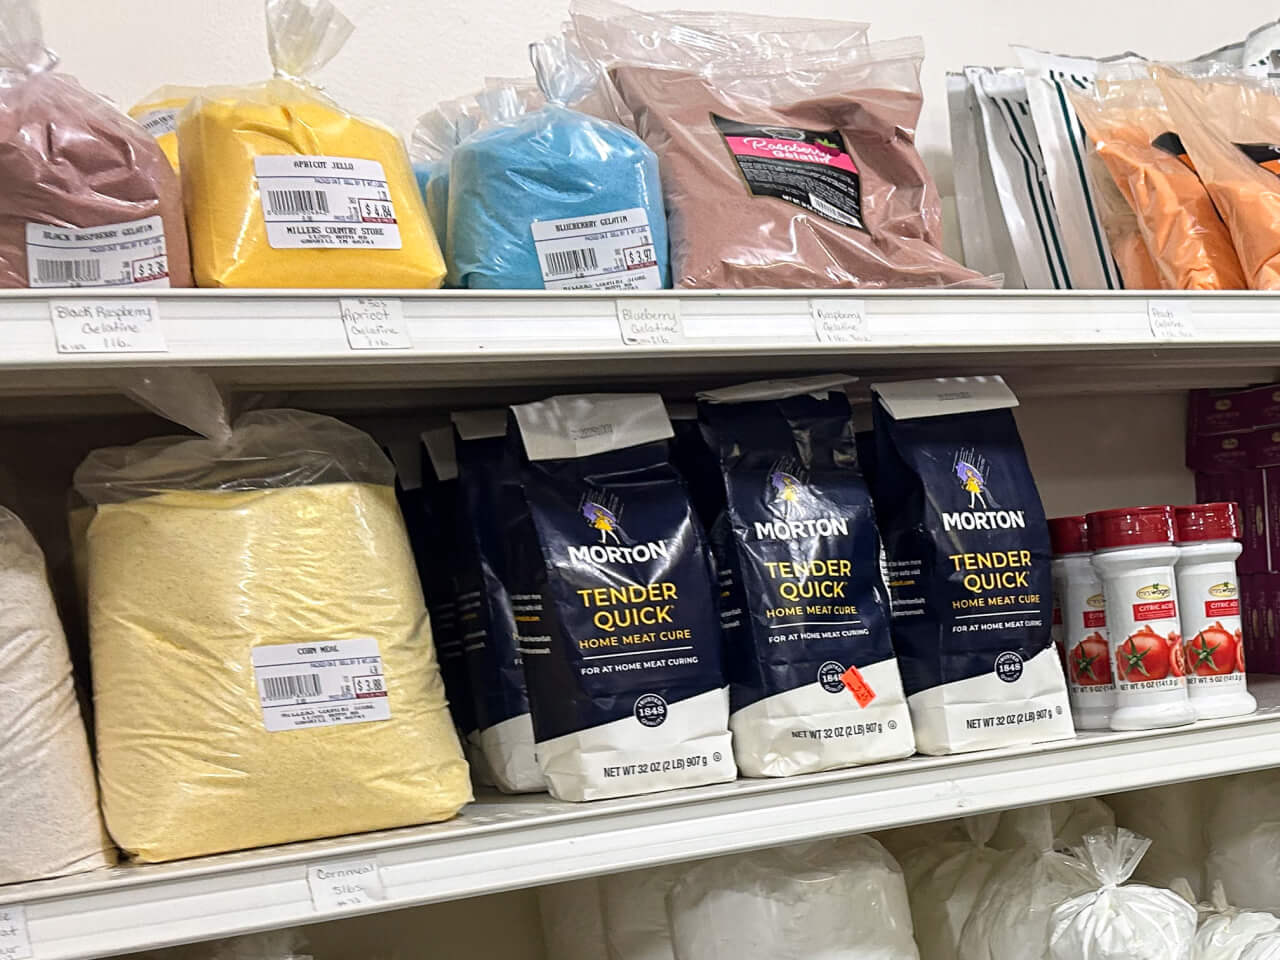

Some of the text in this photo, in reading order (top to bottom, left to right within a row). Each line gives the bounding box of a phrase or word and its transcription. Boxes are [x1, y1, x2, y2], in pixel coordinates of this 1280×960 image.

[744, 137, 832, 159] Raspberry
[772, 150, 830, 164] Gelatin
[294, 161, 354, 170] APRICOT JELLO
[286, 226, 385, 235] MILLERS COUNTRY STORE
[555, 216, 628, 232] BLUEBERRY GELATIN
[55, 305, 152, 322] Black Raspberry
[342, 309, 391, 322] Apricot
[622, 309, 677, 325] Blueberry
[754, 518, 849, 540] MORTON
[942, 511, 1026, 531] MORTON
[567, 540, 669, 564] MORTON
[949, 550, 1032, 572] TENDER
[764, 560, 851, 579] TENDER
[963, 571, 1028, 593] QUICK
[577, 583, 678, 607] TENDER
[780, 581, 845, 601] QUICK
[952, 594, 1040, 609] HOME MEAT CURE
[1138, 603, 1159, 612] CITRIC
[593, 606, 673, 631] QUICK
[766, 606, 857, 618] HOME MEAT CURE
[952, 625, 968, 633] FOR
[981, 622, 1003, 630] HOME
[1004, 620, 1024, 628] MEAT
[579, 629, 692, 649] HOME MEAT CURE
[768, 628, 870, 644] FOR AT HOME MEAT CURING
[297, 645, 340, 655] CORN MEAL
[581, 656, 698, 675] FOR AT HOME MEAT CURING
[999, 663, 1021, 673] 1848
[1215, 674, 1222, 682] OZ
[639, 706, 664, 717] 1848
[966, 719, 981, 729] NET
[983, 718, 995, 728] WT
[996, 717, 1005, 726] 32
[1006, 715, 1016, 724] OZ
[1024, 711, 1035, 723] LB)
[791, 730, 808, 739] NET
[810, 729, 822, 739] WT
[824, 728, 833, 739] 32
[835, 727, 844, 737] OZ
[853, 724, 865, 735] LB)
[604, 755, 708, 778] NET WT 32 OZ (2 LB) 907 g
[316, 864, 374, 880] Cornmeal
